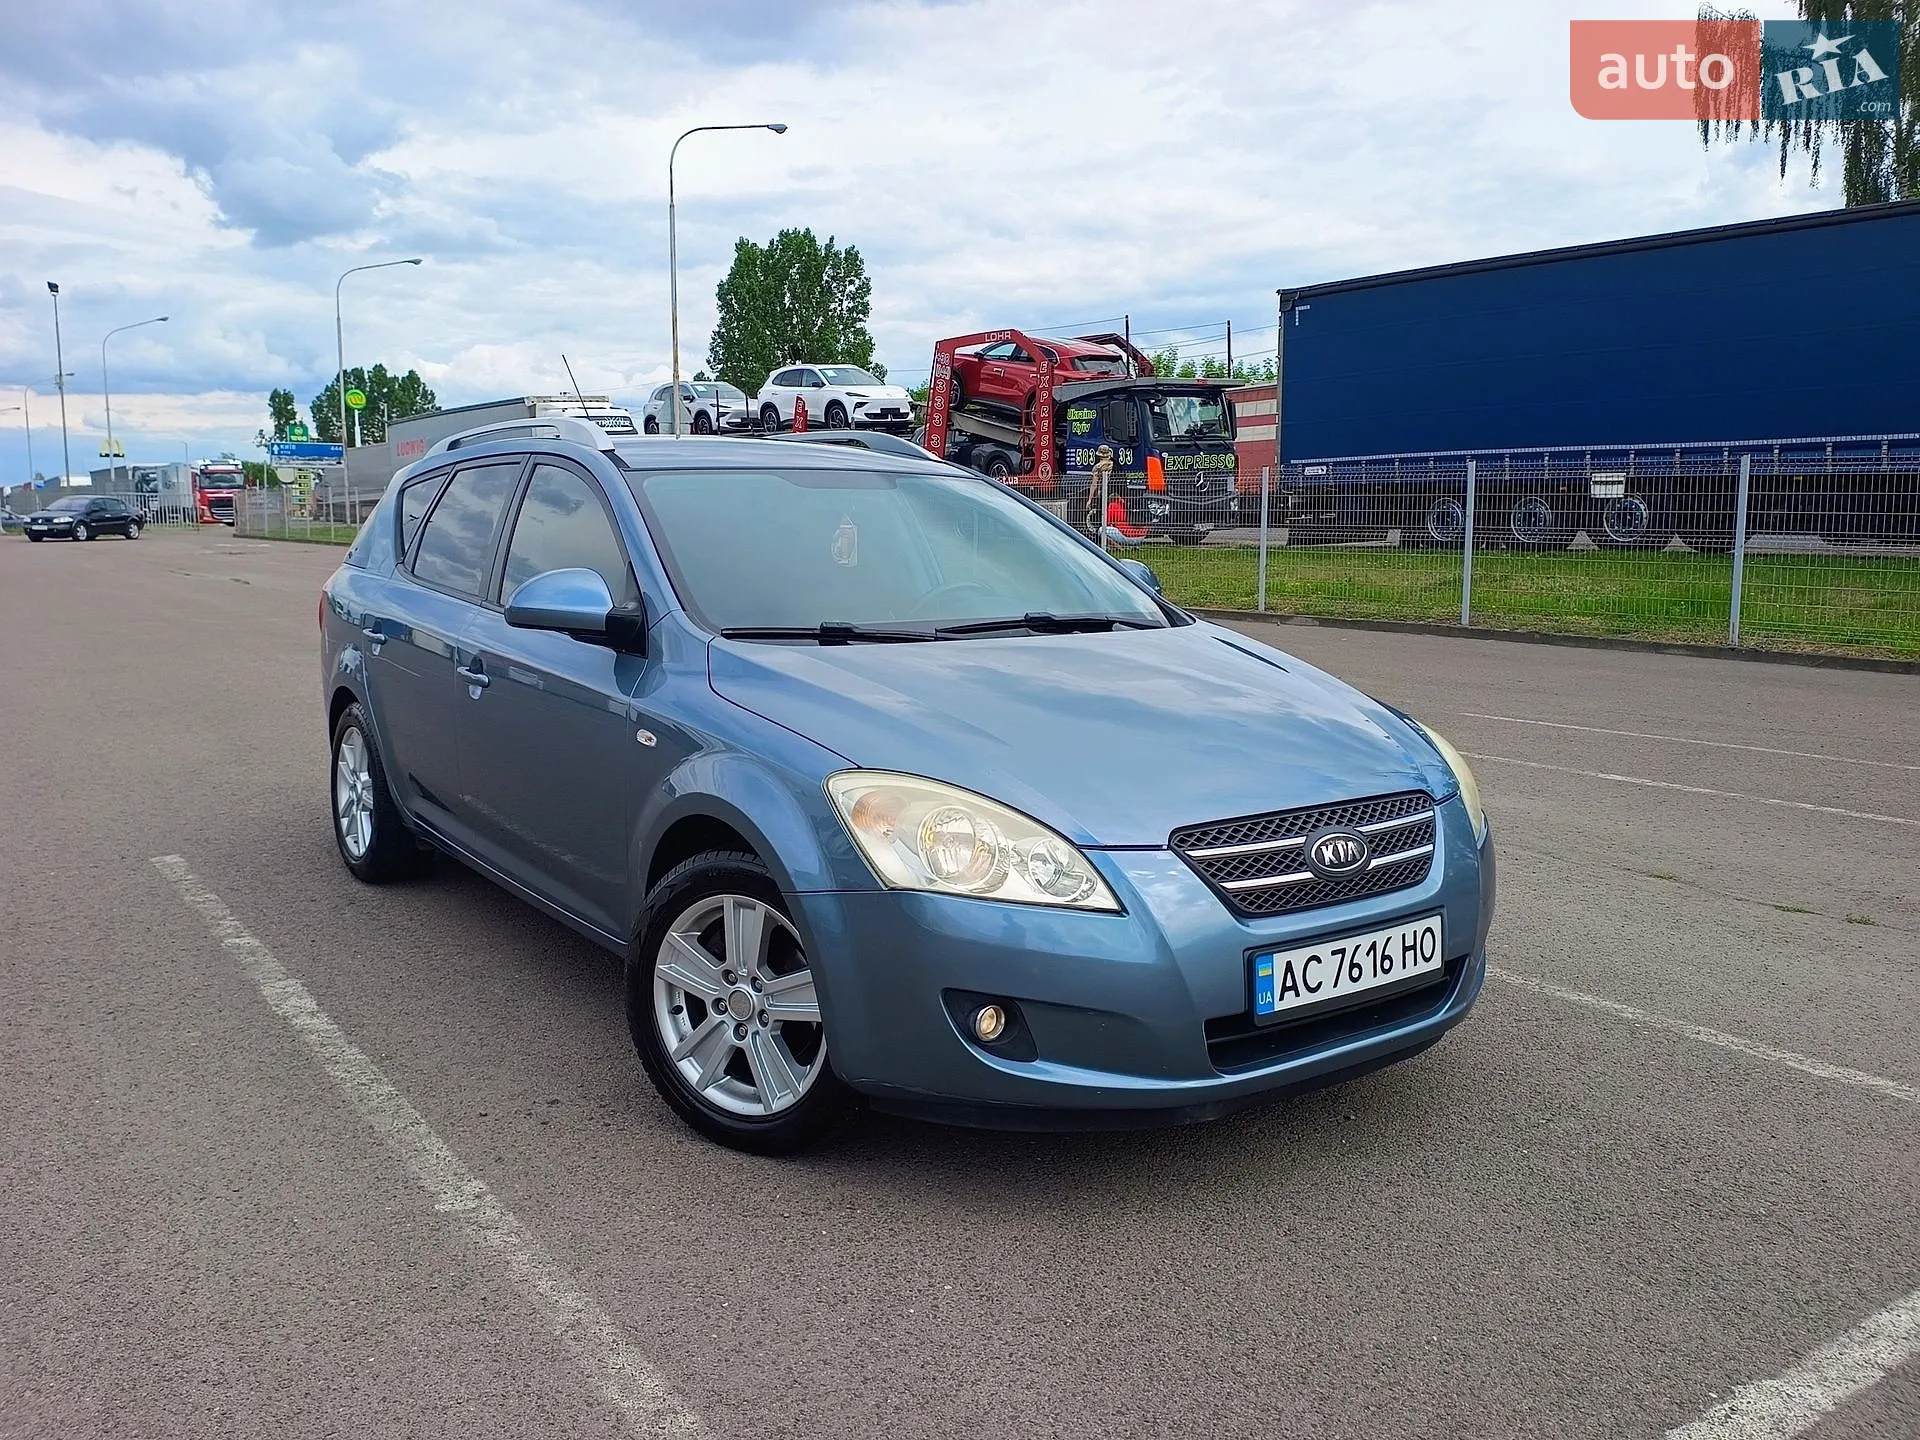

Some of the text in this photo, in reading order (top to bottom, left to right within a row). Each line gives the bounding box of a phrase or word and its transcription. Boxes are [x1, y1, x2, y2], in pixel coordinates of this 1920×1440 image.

[984, 331, 1012, 342] LOHR
[1067, 408, 1097, 420] Ukraine
[1071, 421, 1091, 436] Kyiv
[1075, 448, 1096, 466] 583
[1320, 840, 1361, 866] KIA
[1258, 926, 1437, 1005] UA AC 7616 HO
